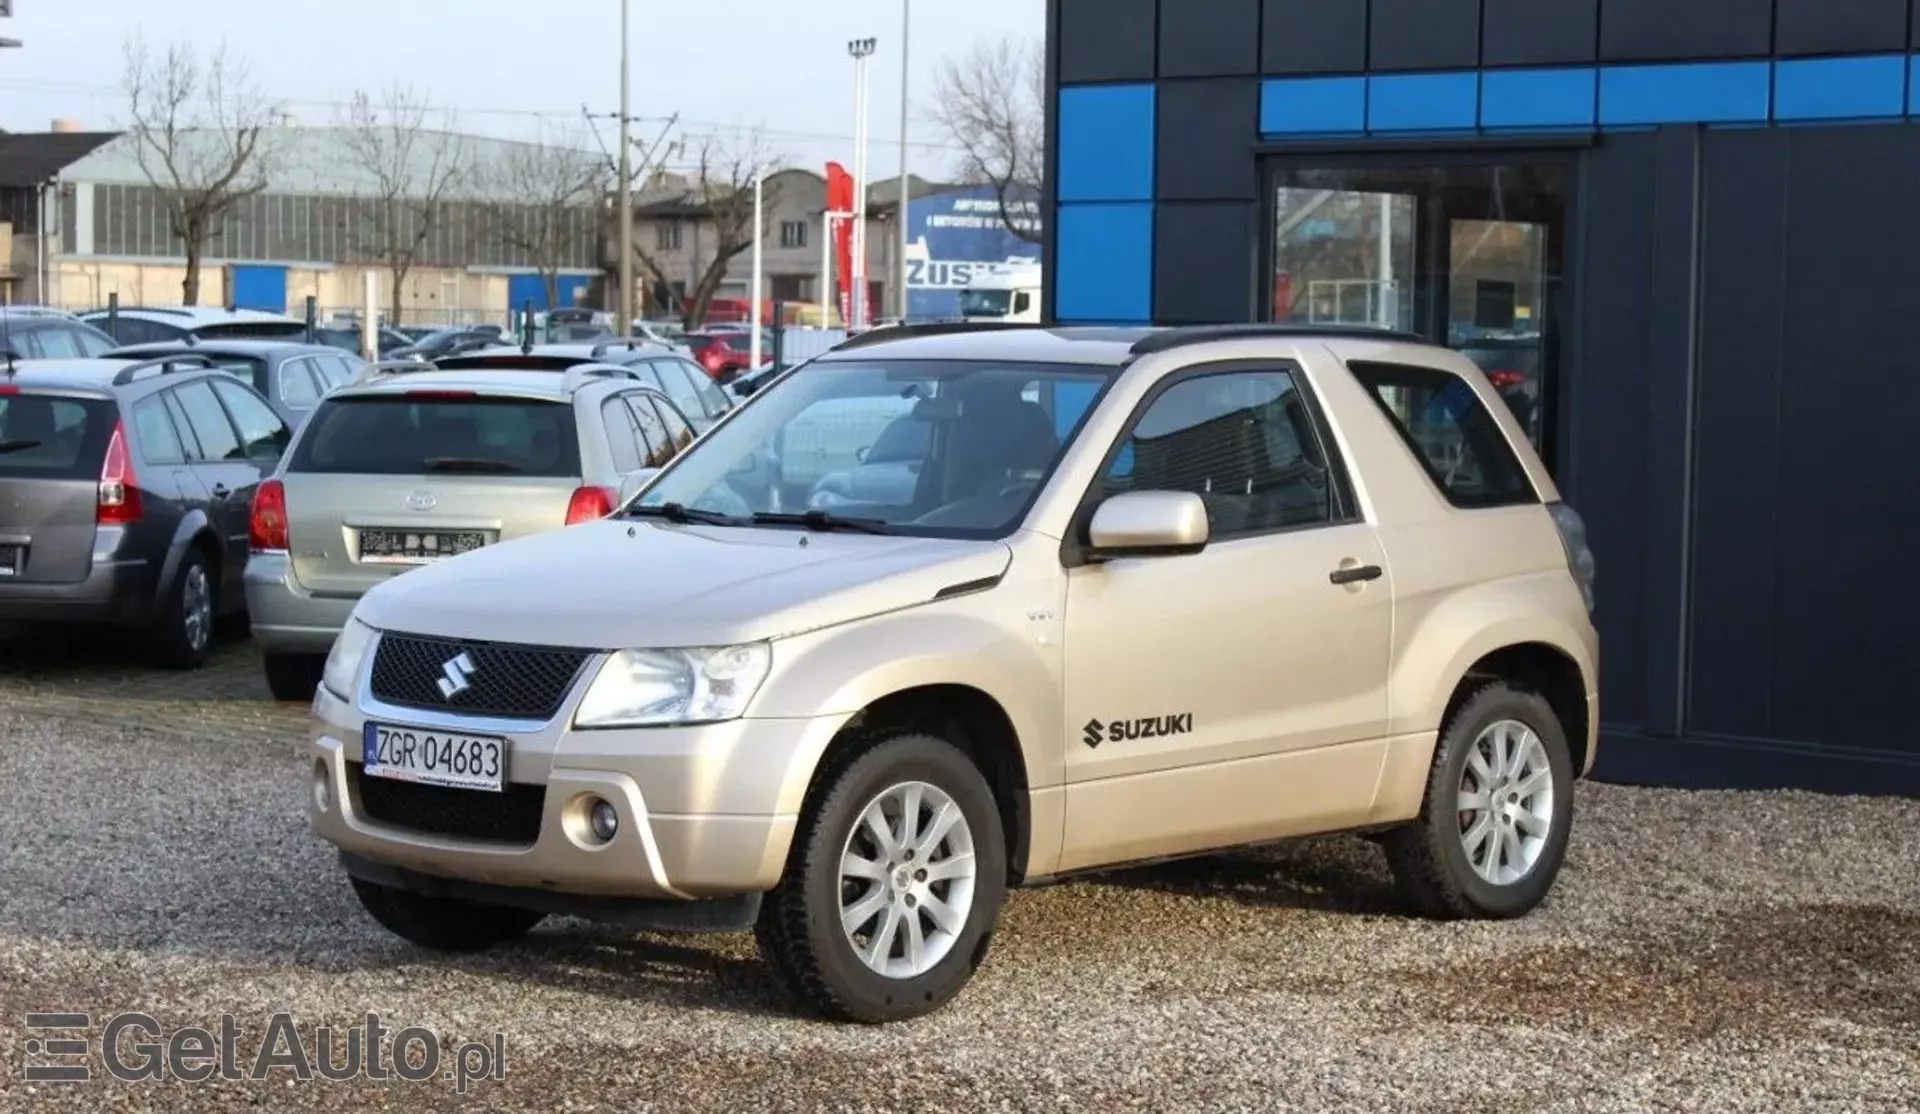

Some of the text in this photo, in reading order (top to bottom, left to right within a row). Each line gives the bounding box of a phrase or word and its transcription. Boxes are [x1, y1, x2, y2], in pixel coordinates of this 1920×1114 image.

[906, 258, 995, 286] ZUS
[1108, 713, 1193, 742] SUZUKI
[377, 729, 499, 778] ZGR 04683
